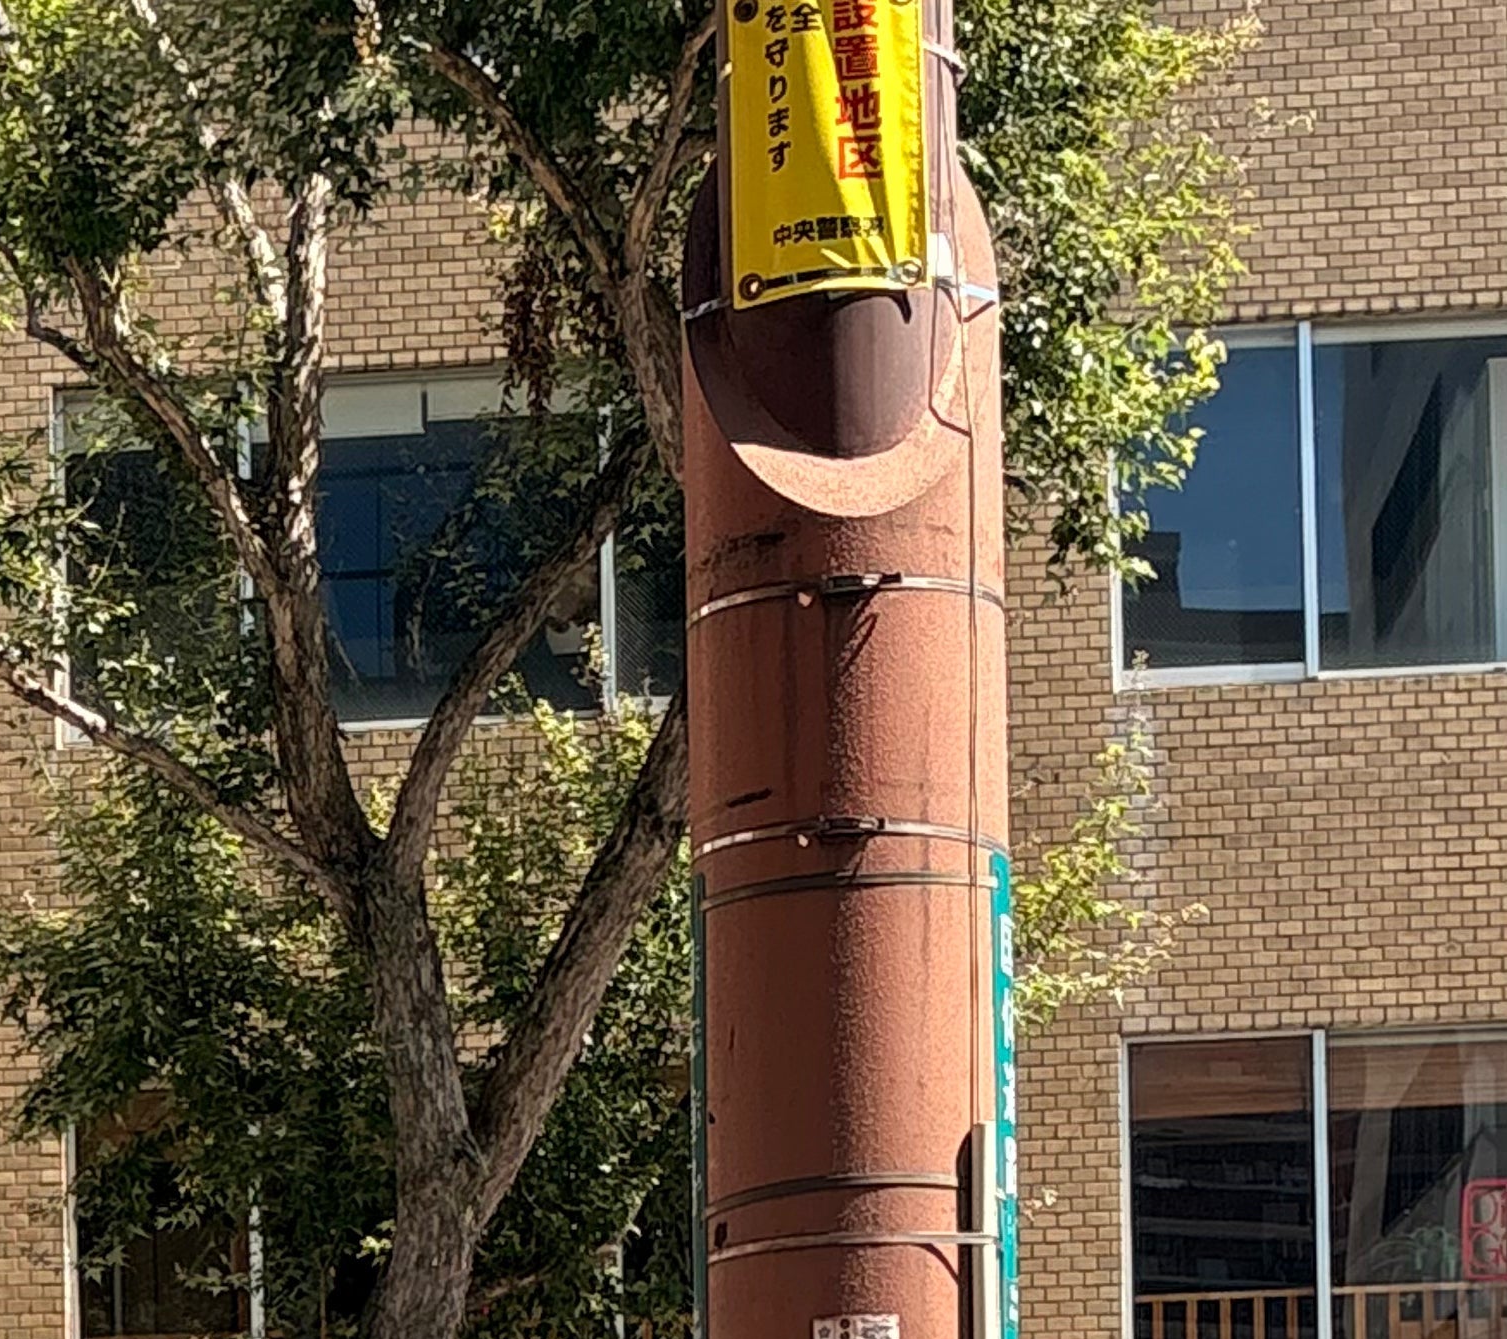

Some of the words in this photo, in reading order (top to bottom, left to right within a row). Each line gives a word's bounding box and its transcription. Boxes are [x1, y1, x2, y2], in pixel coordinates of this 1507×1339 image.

[765, 5, 791, 172] を守ります
[834, 0, 883, 180] 設置地区
